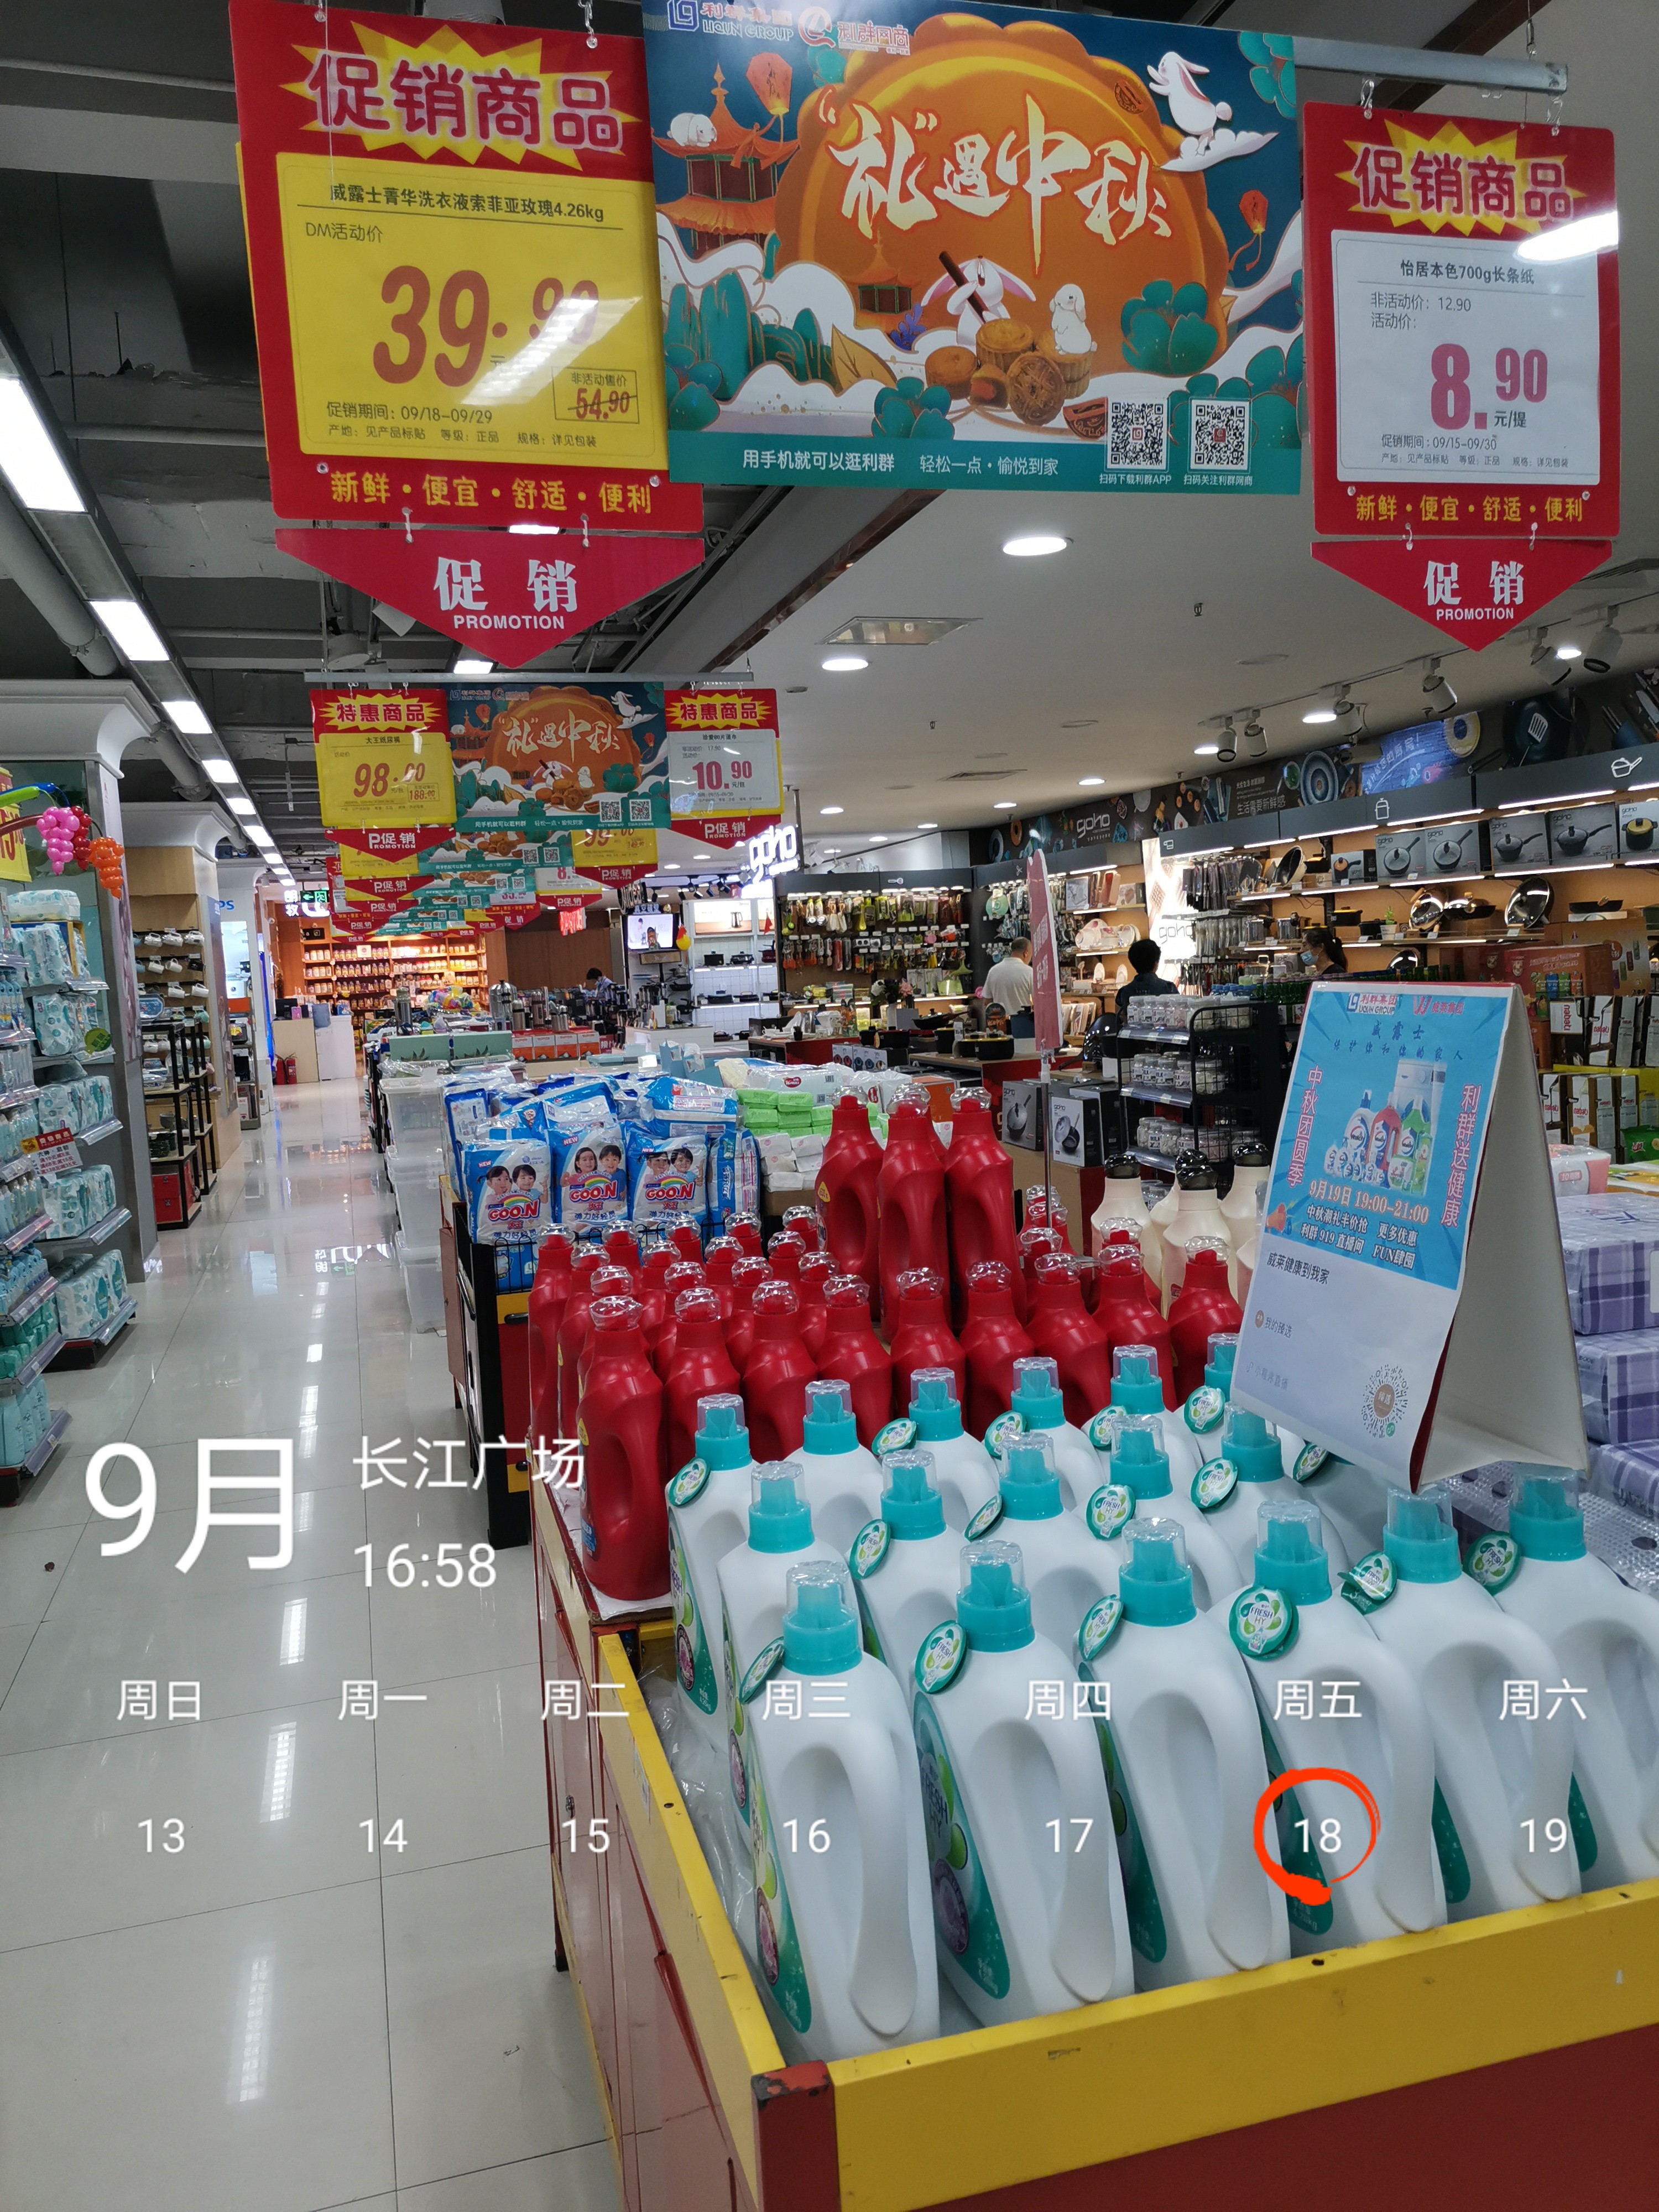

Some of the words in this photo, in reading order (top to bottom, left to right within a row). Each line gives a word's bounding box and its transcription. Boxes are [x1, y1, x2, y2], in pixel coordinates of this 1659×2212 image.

[744, 24, 794, 42] GROUP
[308, 54, 622, 150] 促销商品
[1354, 147, 1572, 219] 促销商品
[330, 184, 604, 222] 威露士菁华洗衣液索菲亚玫瑰4.26kg
[305, 222, 383, 243] DM活动价
[1401, 259, 1535, 285] 怡居本色700g长条纸
[571, 371, 627, 388] 非活动售价
[1431, 343, 1548, 430] 8.90
[1494, 410, 1527, 429] 元/提
[743, 450, 895, 472] 用手机就可以逛利群
[919, 455, 1058, 476] 轻松一点·愉悦到家
[1099, 473, 1172, 485] 扫码下载利群APP
[1183, 474, 1253, 486] 扫码关注利群网商
[434, 556, 577, 613] 促销
[1423, 560, 1524, 606] 促销
[453, 614, 565, 630] PROMOTION
[1436, 607, 1514, 620] PROMOTION
[336, 703, 426, 723] 特惠商品
[680, 700, 758, 721] 特惠商品
[692, 760, 753, 791] 10.90
[1076, 813, 1110, 839] goho
[1361, 994, 1397, 1005] 利群集团
[1375, 1005, 1395, 1014] GROUP
[1287, 1065, 1323, 1188] 中秋团圆季
[563, 1136, 579, 1146] NEW
[1441, 1084, 1482, 1228] 利群送健康
[588, 1201, 604, 1211] 大王
[663, 1200, 679, 1210] 大王
[1308, 1178, 1353, 1208] 9月19日
[1354, 1190, 1430, 1225] 19:00-21:00
[507, 1220, 524, 1229] 大王
[1306, 1204, 1369, 1234] 中秋潮礼半价抢
[1376, 1221, 1418, 1247] 更多优惠
[1301, 1223, 1319, 1241] 利群
[1319, 1230, 1336, 1244] 919
[1335, 1233, 1365, 1255] 直播间
[1266, 1251, 1330, 1285] 威莱健康到我家
[1102, 1500, 1120, 1510] FRESH
[1250, 1605, 1274, 1620] FRESH
